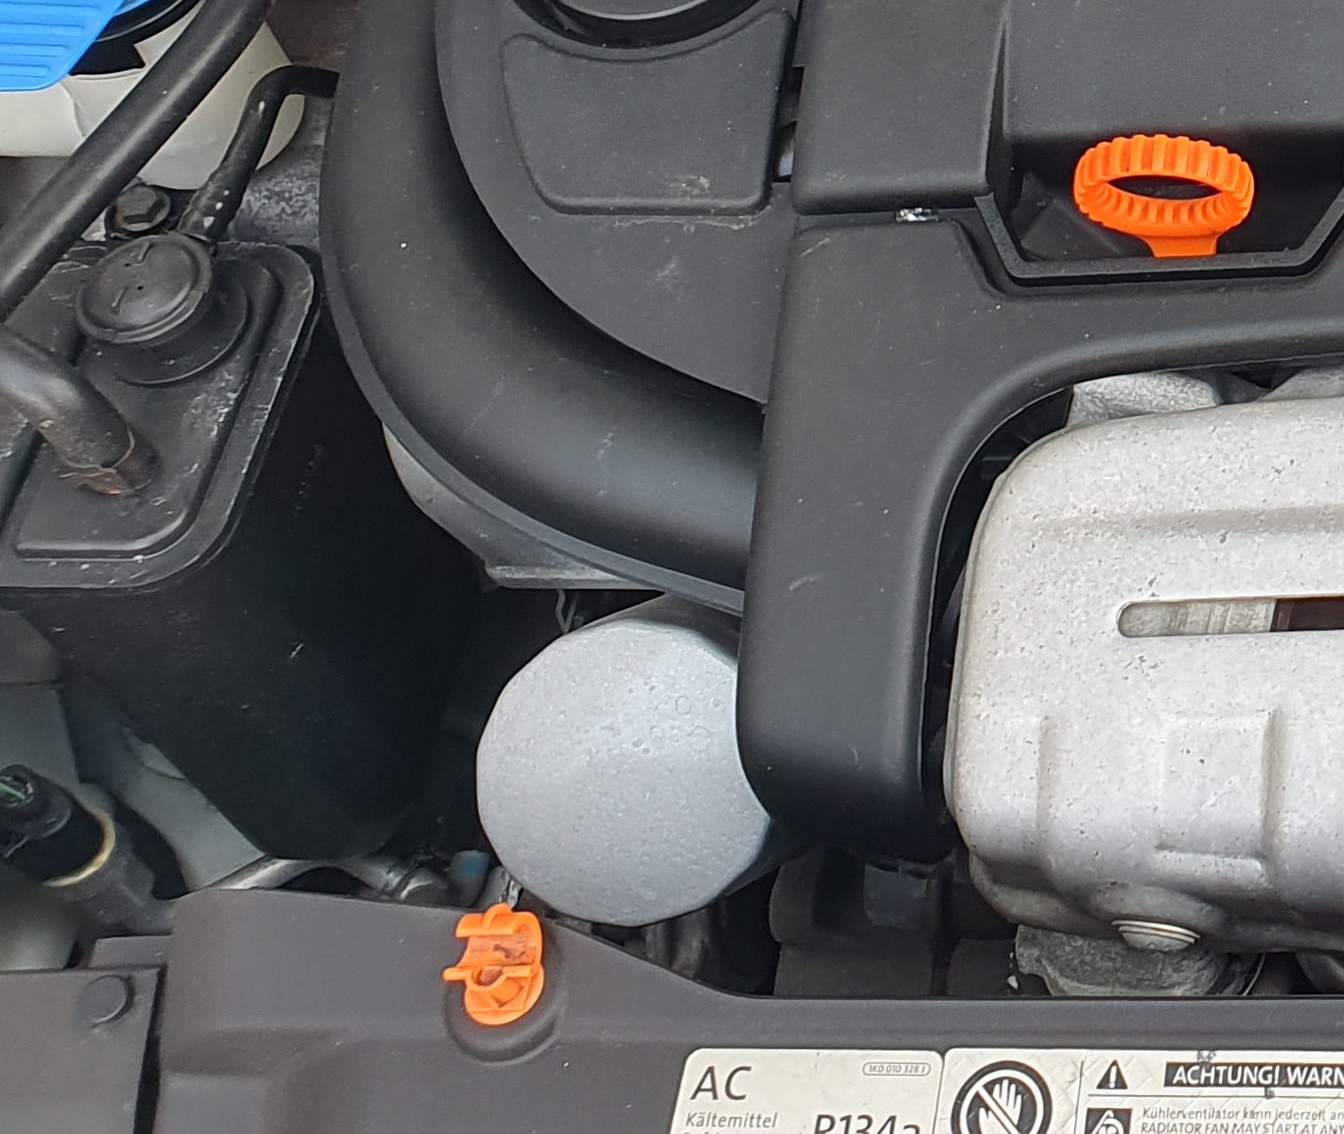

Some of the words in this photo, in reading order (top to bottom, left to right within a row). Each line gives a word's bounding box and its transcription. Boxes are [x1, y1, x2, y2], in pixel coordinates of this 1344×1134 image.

[690, 1066, 752, 1100] AC
[1172, 1065, 1280, 1086] ACHTUNG!
[685, 1112, 779, 1129] Kältemittel
[1142, 1106, 1239, 1120] Kühlerventilator
[1243, 1106, 1271, 1120] kann
[1141, 1122, 1201, 1134] RADIATOR
[1204, 1122, 1228, 1134] FAN
[1231, 1122, 1261, 1134] MAY
[1301, 1123, 1317, 1134] AT
